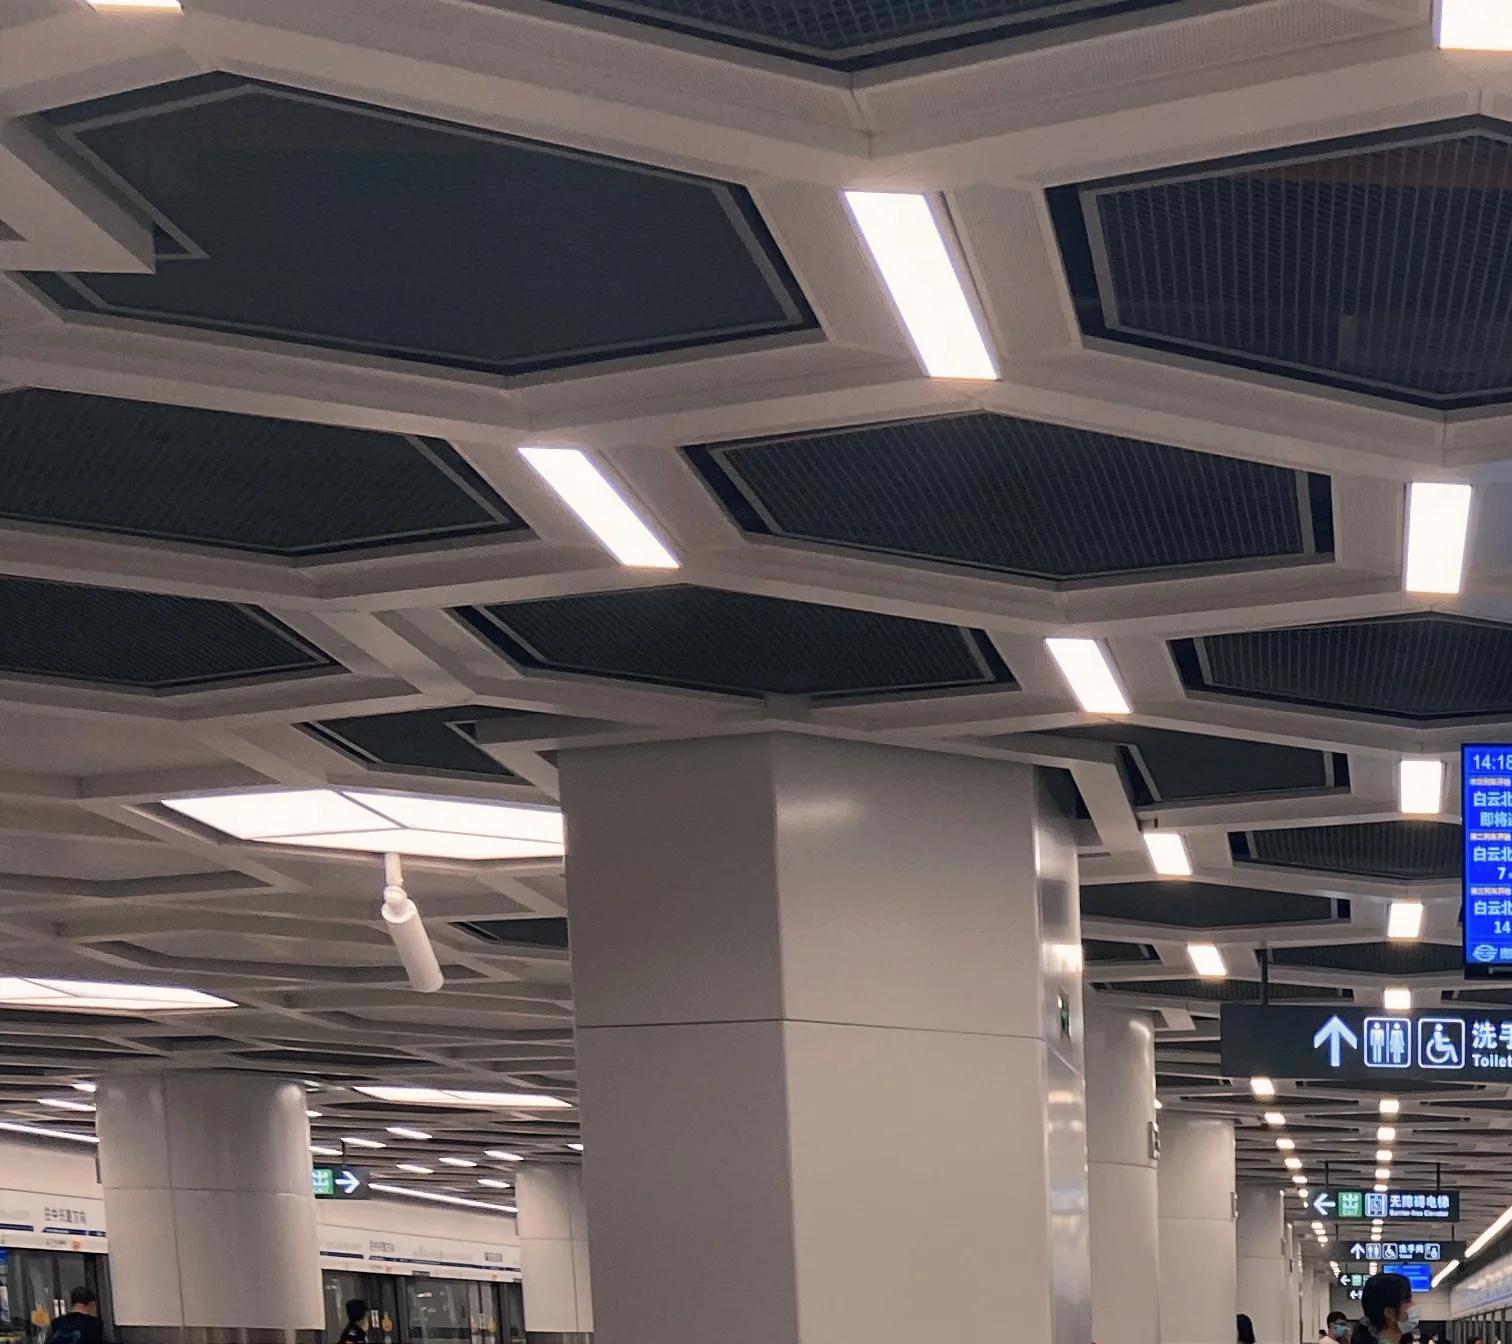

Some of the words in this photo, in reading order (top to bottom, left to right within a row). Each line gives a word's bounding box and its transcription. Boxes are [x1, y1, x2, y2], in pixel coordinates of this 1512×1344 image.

[1497, 867, 1506, 880] 7
[1493, 921, 1511, 934] 14
[1472, 1054, 1512, 1068] Toilet
[1342, 1192, 1359, 1208] 出
[1390, 1195, 1450, 1209] 无障碍电梯
